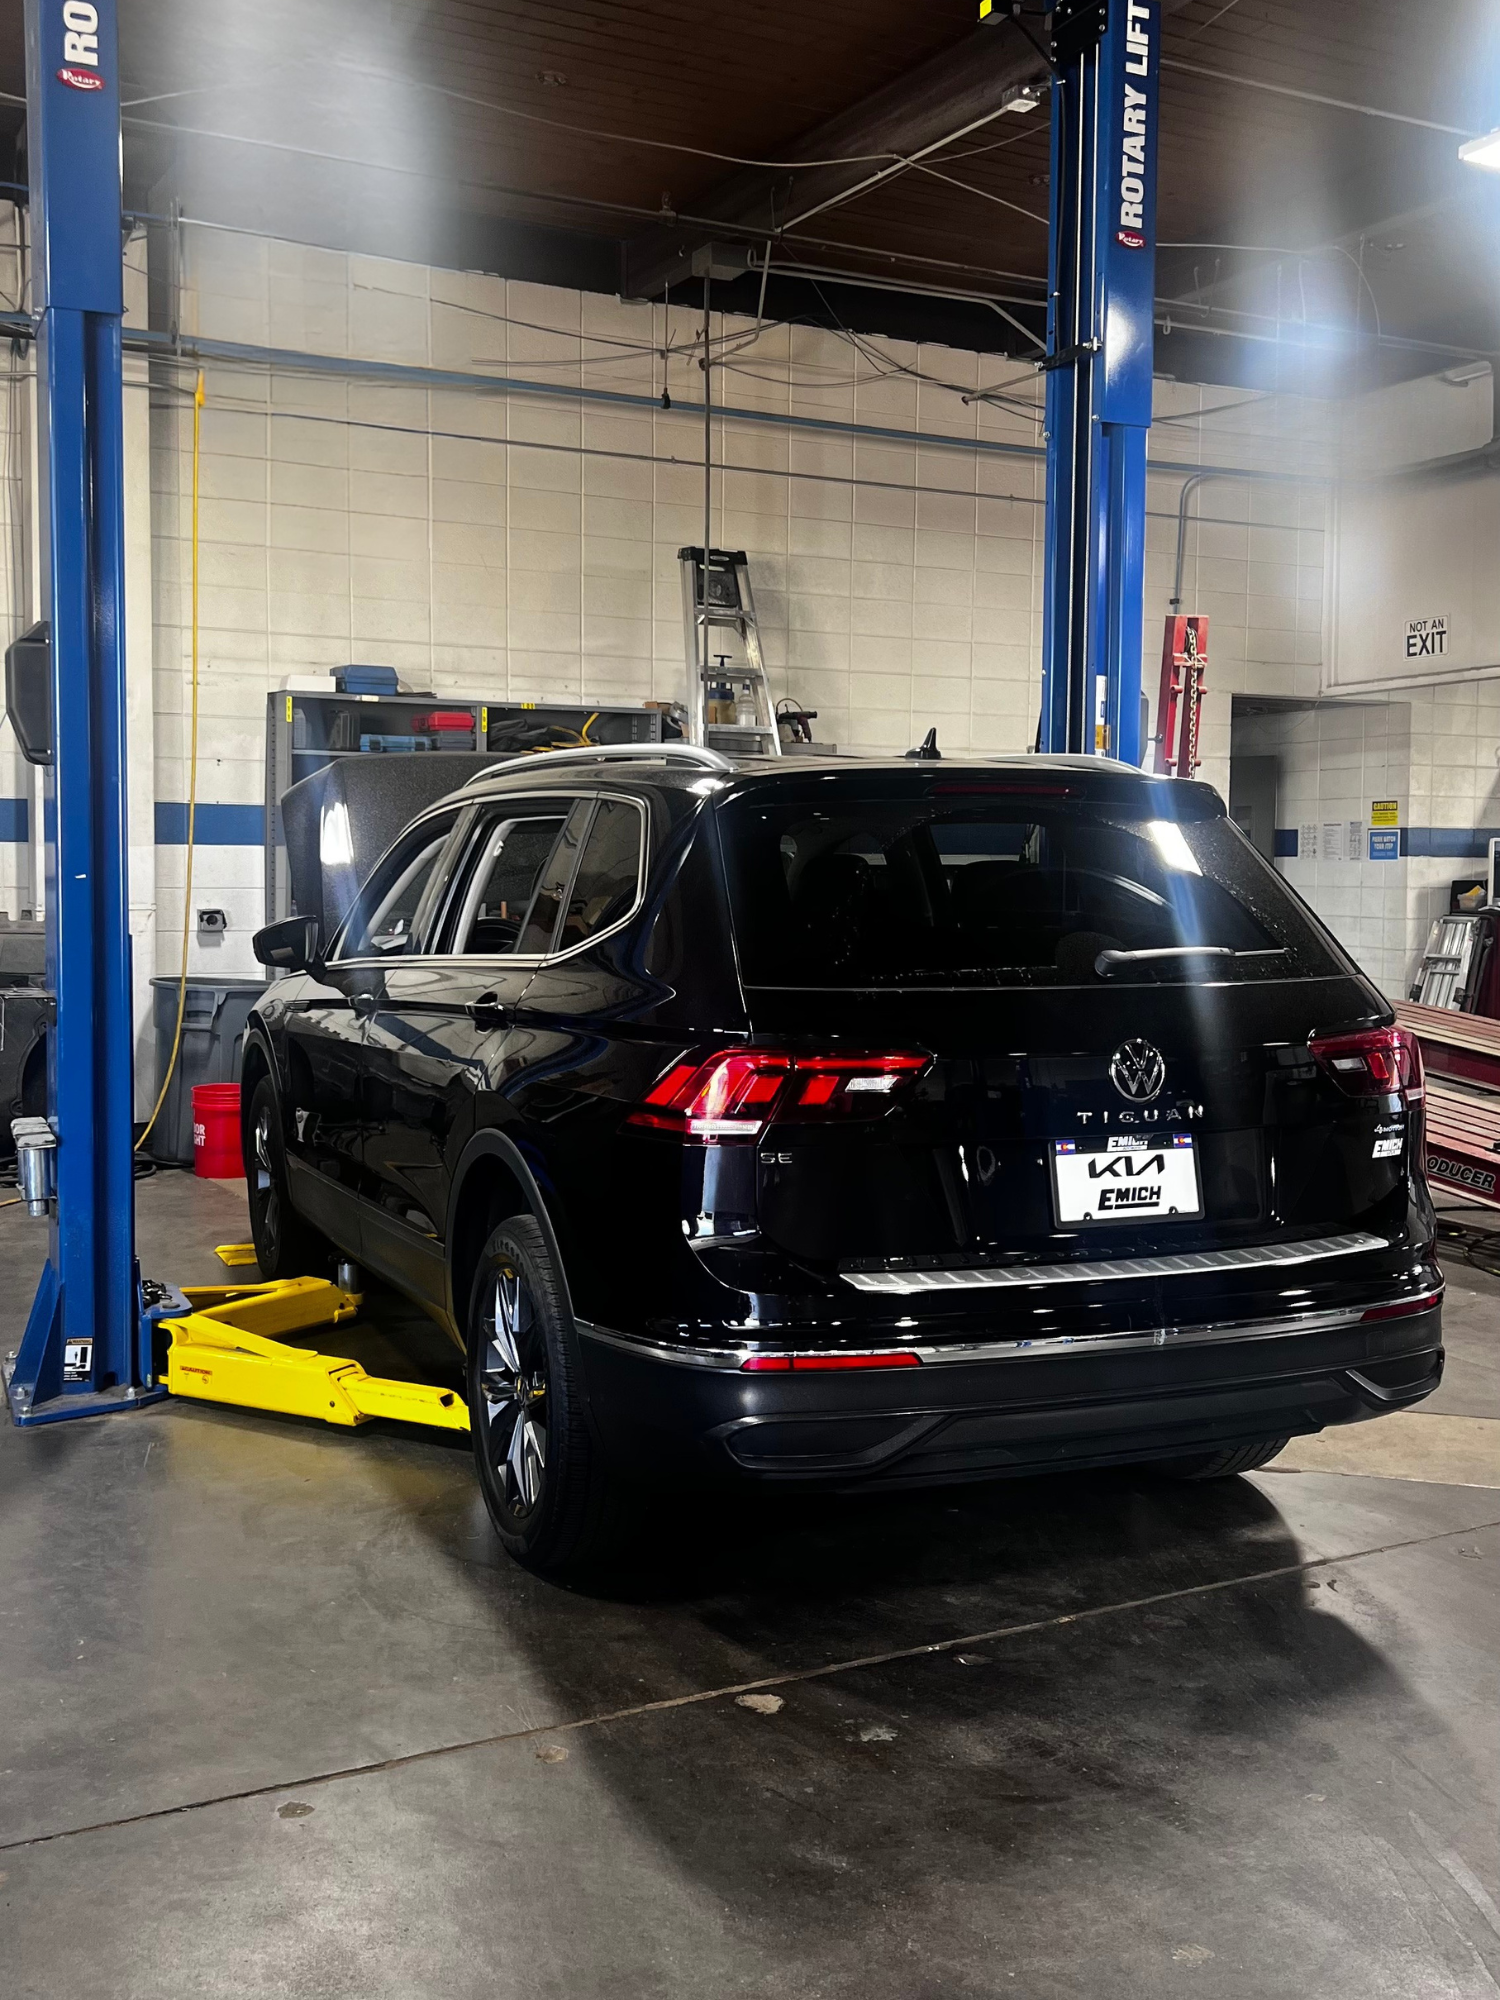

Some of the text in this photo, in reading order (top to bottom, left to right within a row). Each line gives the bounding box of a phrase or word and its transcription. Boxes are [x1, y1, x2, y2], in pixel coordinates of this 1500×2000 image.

[1120, 0, 1150, 229] ROTARY LIFT
[1409, 618, 1444, 633] NOT AN
[1406, 630, 1447, 657] EXIT
[1373, 802, 1397, 810] CAUTION
[1076, 1104, 1204, 1125] TIGUAN
[760, 1152, 793, 1164] SE
[1371, 1138, 1404, 1159] EMICH
[1088, 1153, 1165, 1179] KIA
[1098, 1185, 1162, 1211] EMICH
